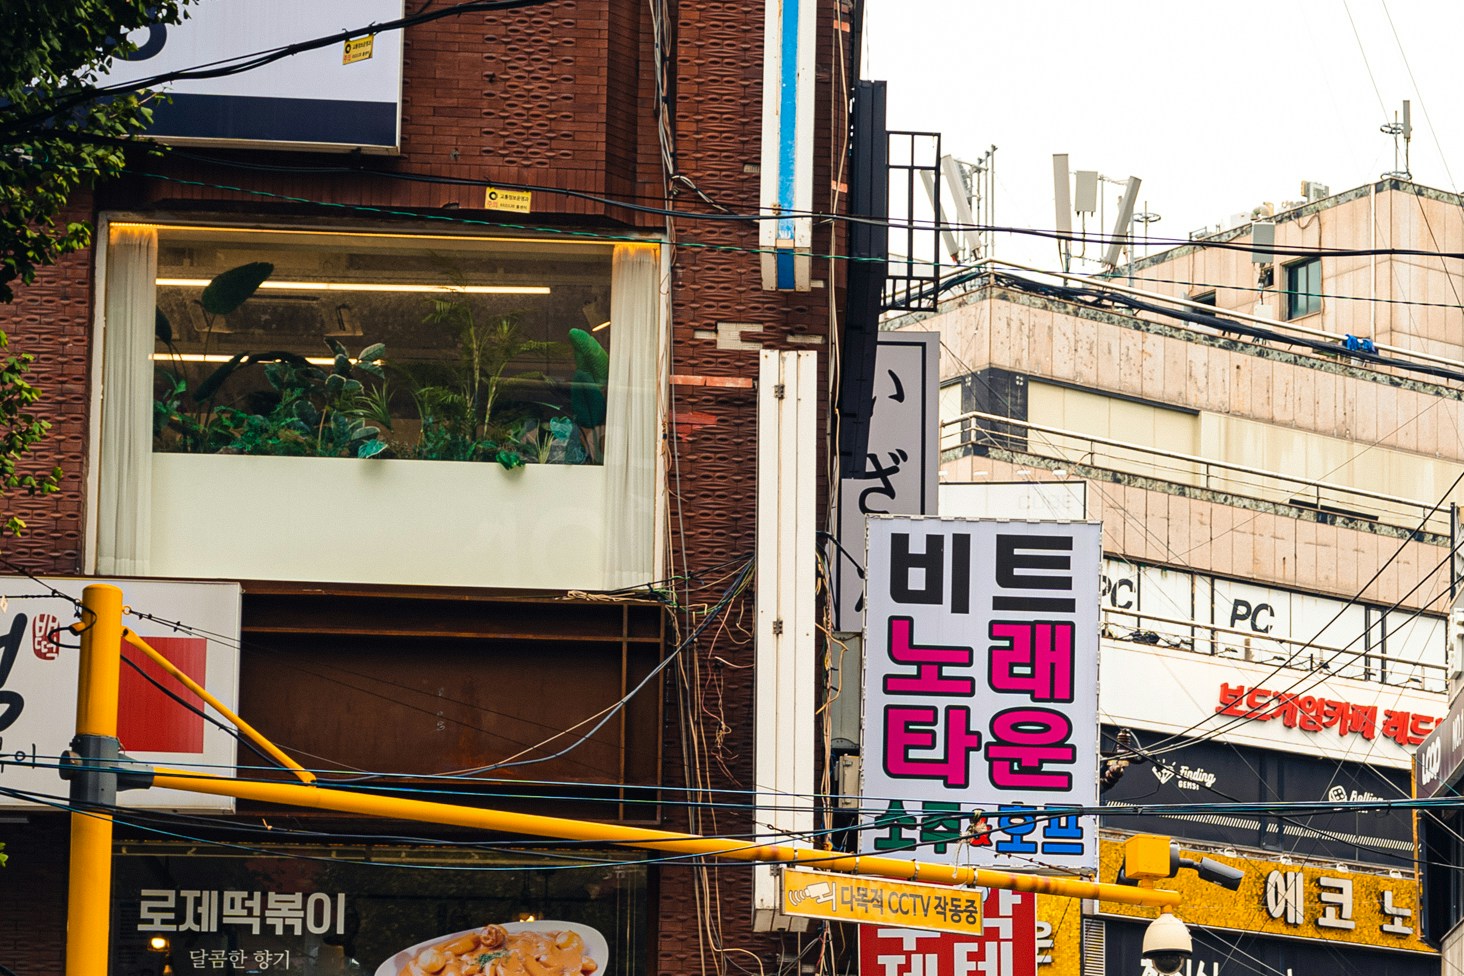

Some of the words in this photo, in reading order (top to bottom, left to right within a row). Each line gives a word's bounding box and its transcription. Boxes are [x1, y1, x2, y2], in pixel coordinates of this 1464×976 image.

[889, 533, 1077, 614] 비트
[1230, 599, 1276, 634] PC
[883, 616, 1076, 703] 노래
[1215, 683, 1377, 741] 보드게임카페
[883, 704, 1077, 792] 타운
[1178, 764, 1216, 788] Finding
[137, 889, 346, 936] 로제떡볶이
[841, 886, 884, 914] 다목적
[888, 890, 931, 918] CCTV
[934, 896, 978, 926] 작동중
[189, 949, 248, 970] 달콤한
[253, 949, 291, 970] 향기
